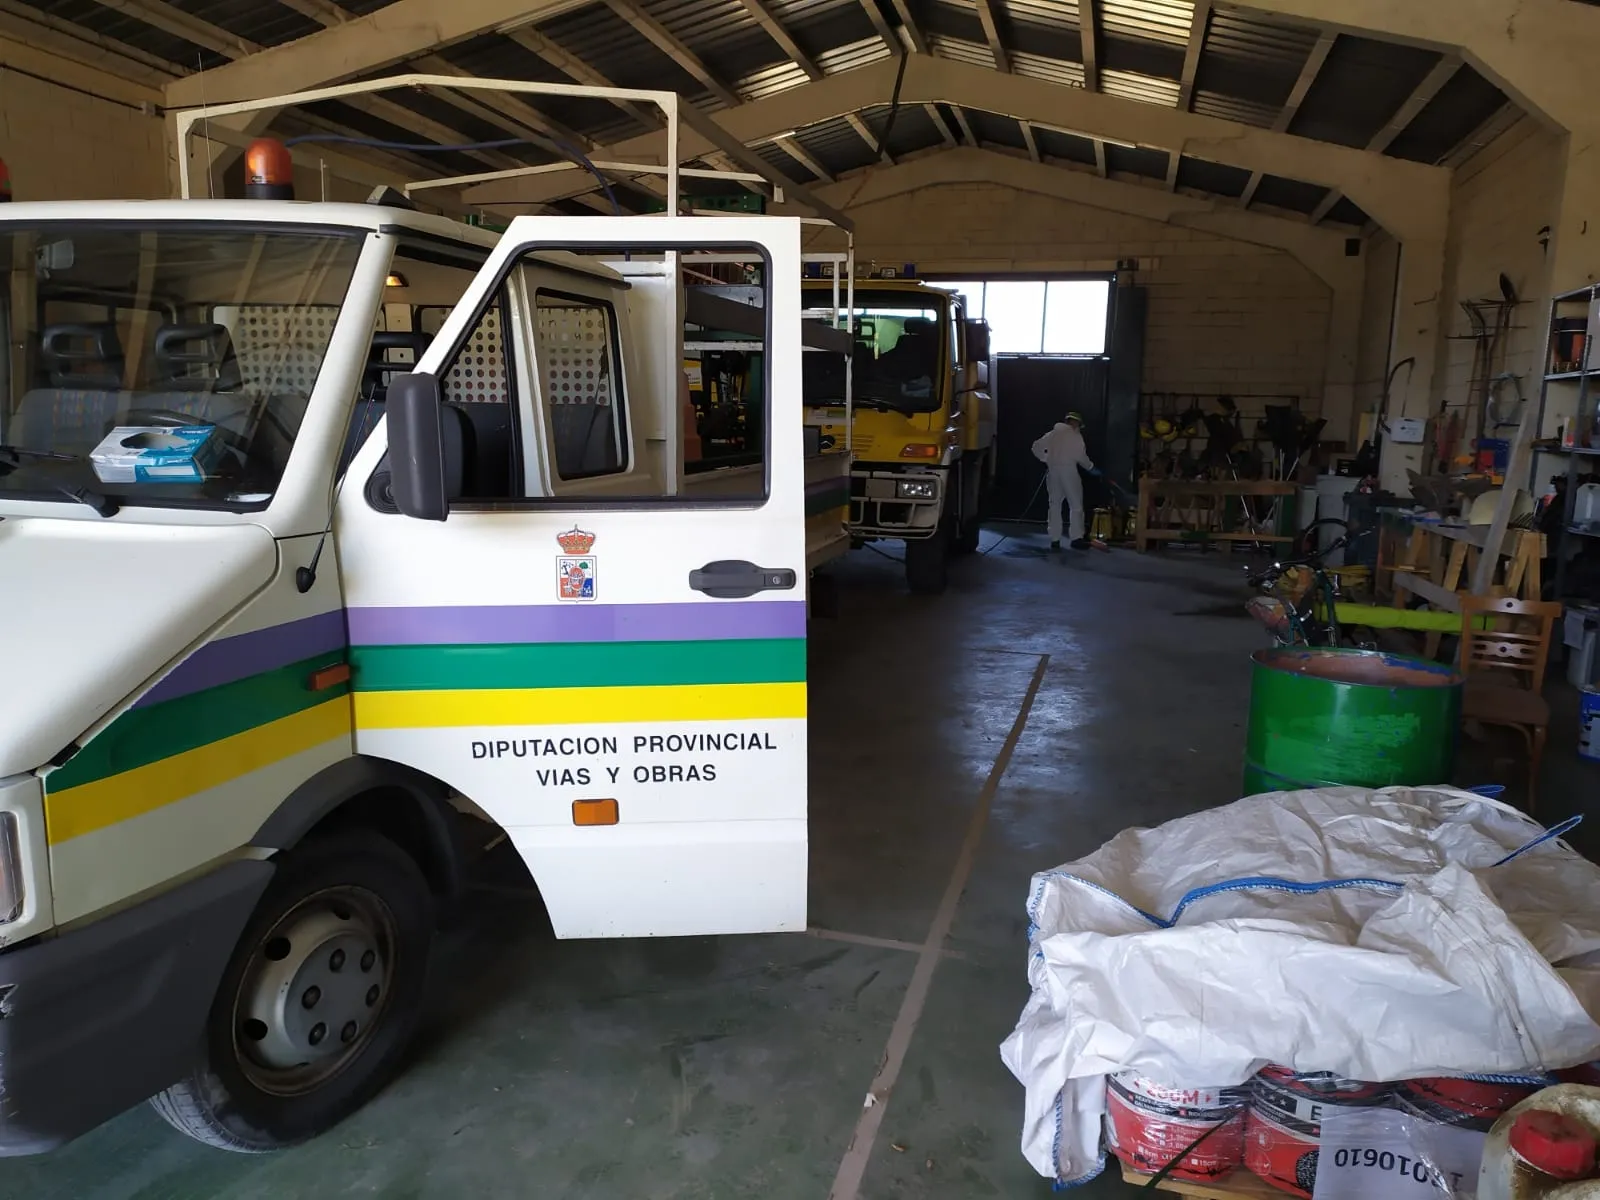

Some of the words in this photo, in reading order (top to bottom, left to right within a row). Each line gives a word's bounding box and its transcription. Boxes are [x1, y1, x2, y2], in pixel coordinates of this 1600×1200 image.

[471, 737, 617, 759] DIPUTACION
[633, 732, 777, 753] PROVINCIAL
[536, 767, 591, 786] VIAS
[606, 767, 620, 784] Y
[633, 764, 717, 783] OBRAS
[1334, 1148, 1464, 1194] 1010610
